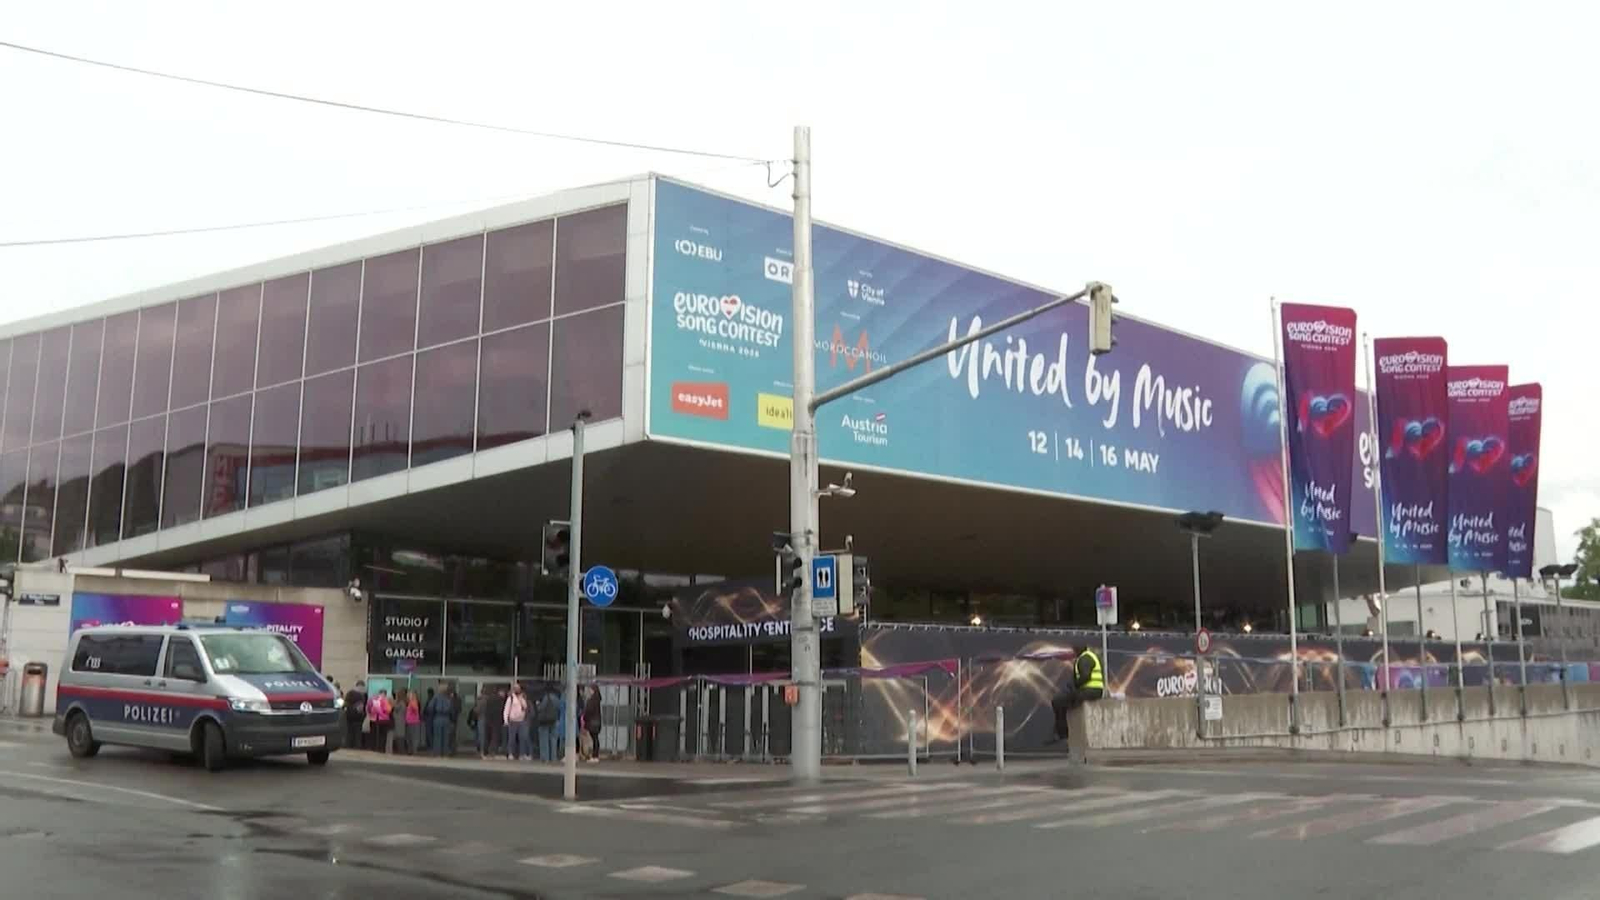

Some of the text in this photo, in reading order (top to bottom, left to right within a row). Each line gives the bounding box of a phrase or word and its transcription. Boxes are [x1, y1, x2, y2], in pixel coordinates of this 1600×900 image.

[698, 244, 723, 262] EBU
[767, 257, 791, 278] OR
[699, 338, 736, 354] VIENNA
[947, 315, 1214, 439] United by Music
[678, 393, 723, 409] easyJet
[841, 414, 888, 435] Austria
[853, 429, 888, 447] Tourism
[1028, 430, 1160, 474] 12 14 16 MAY
[385, 616, 430, 628] STUDIO F
[387, 632, 417, 644] HALLE
[688, 622, 762, 641] HOSPITALITY
[385, 648, 425, 659] GARAGE
[264, 680, 320, 688] POLIZEI
[123, 703, 174, 725] POLIZEI
